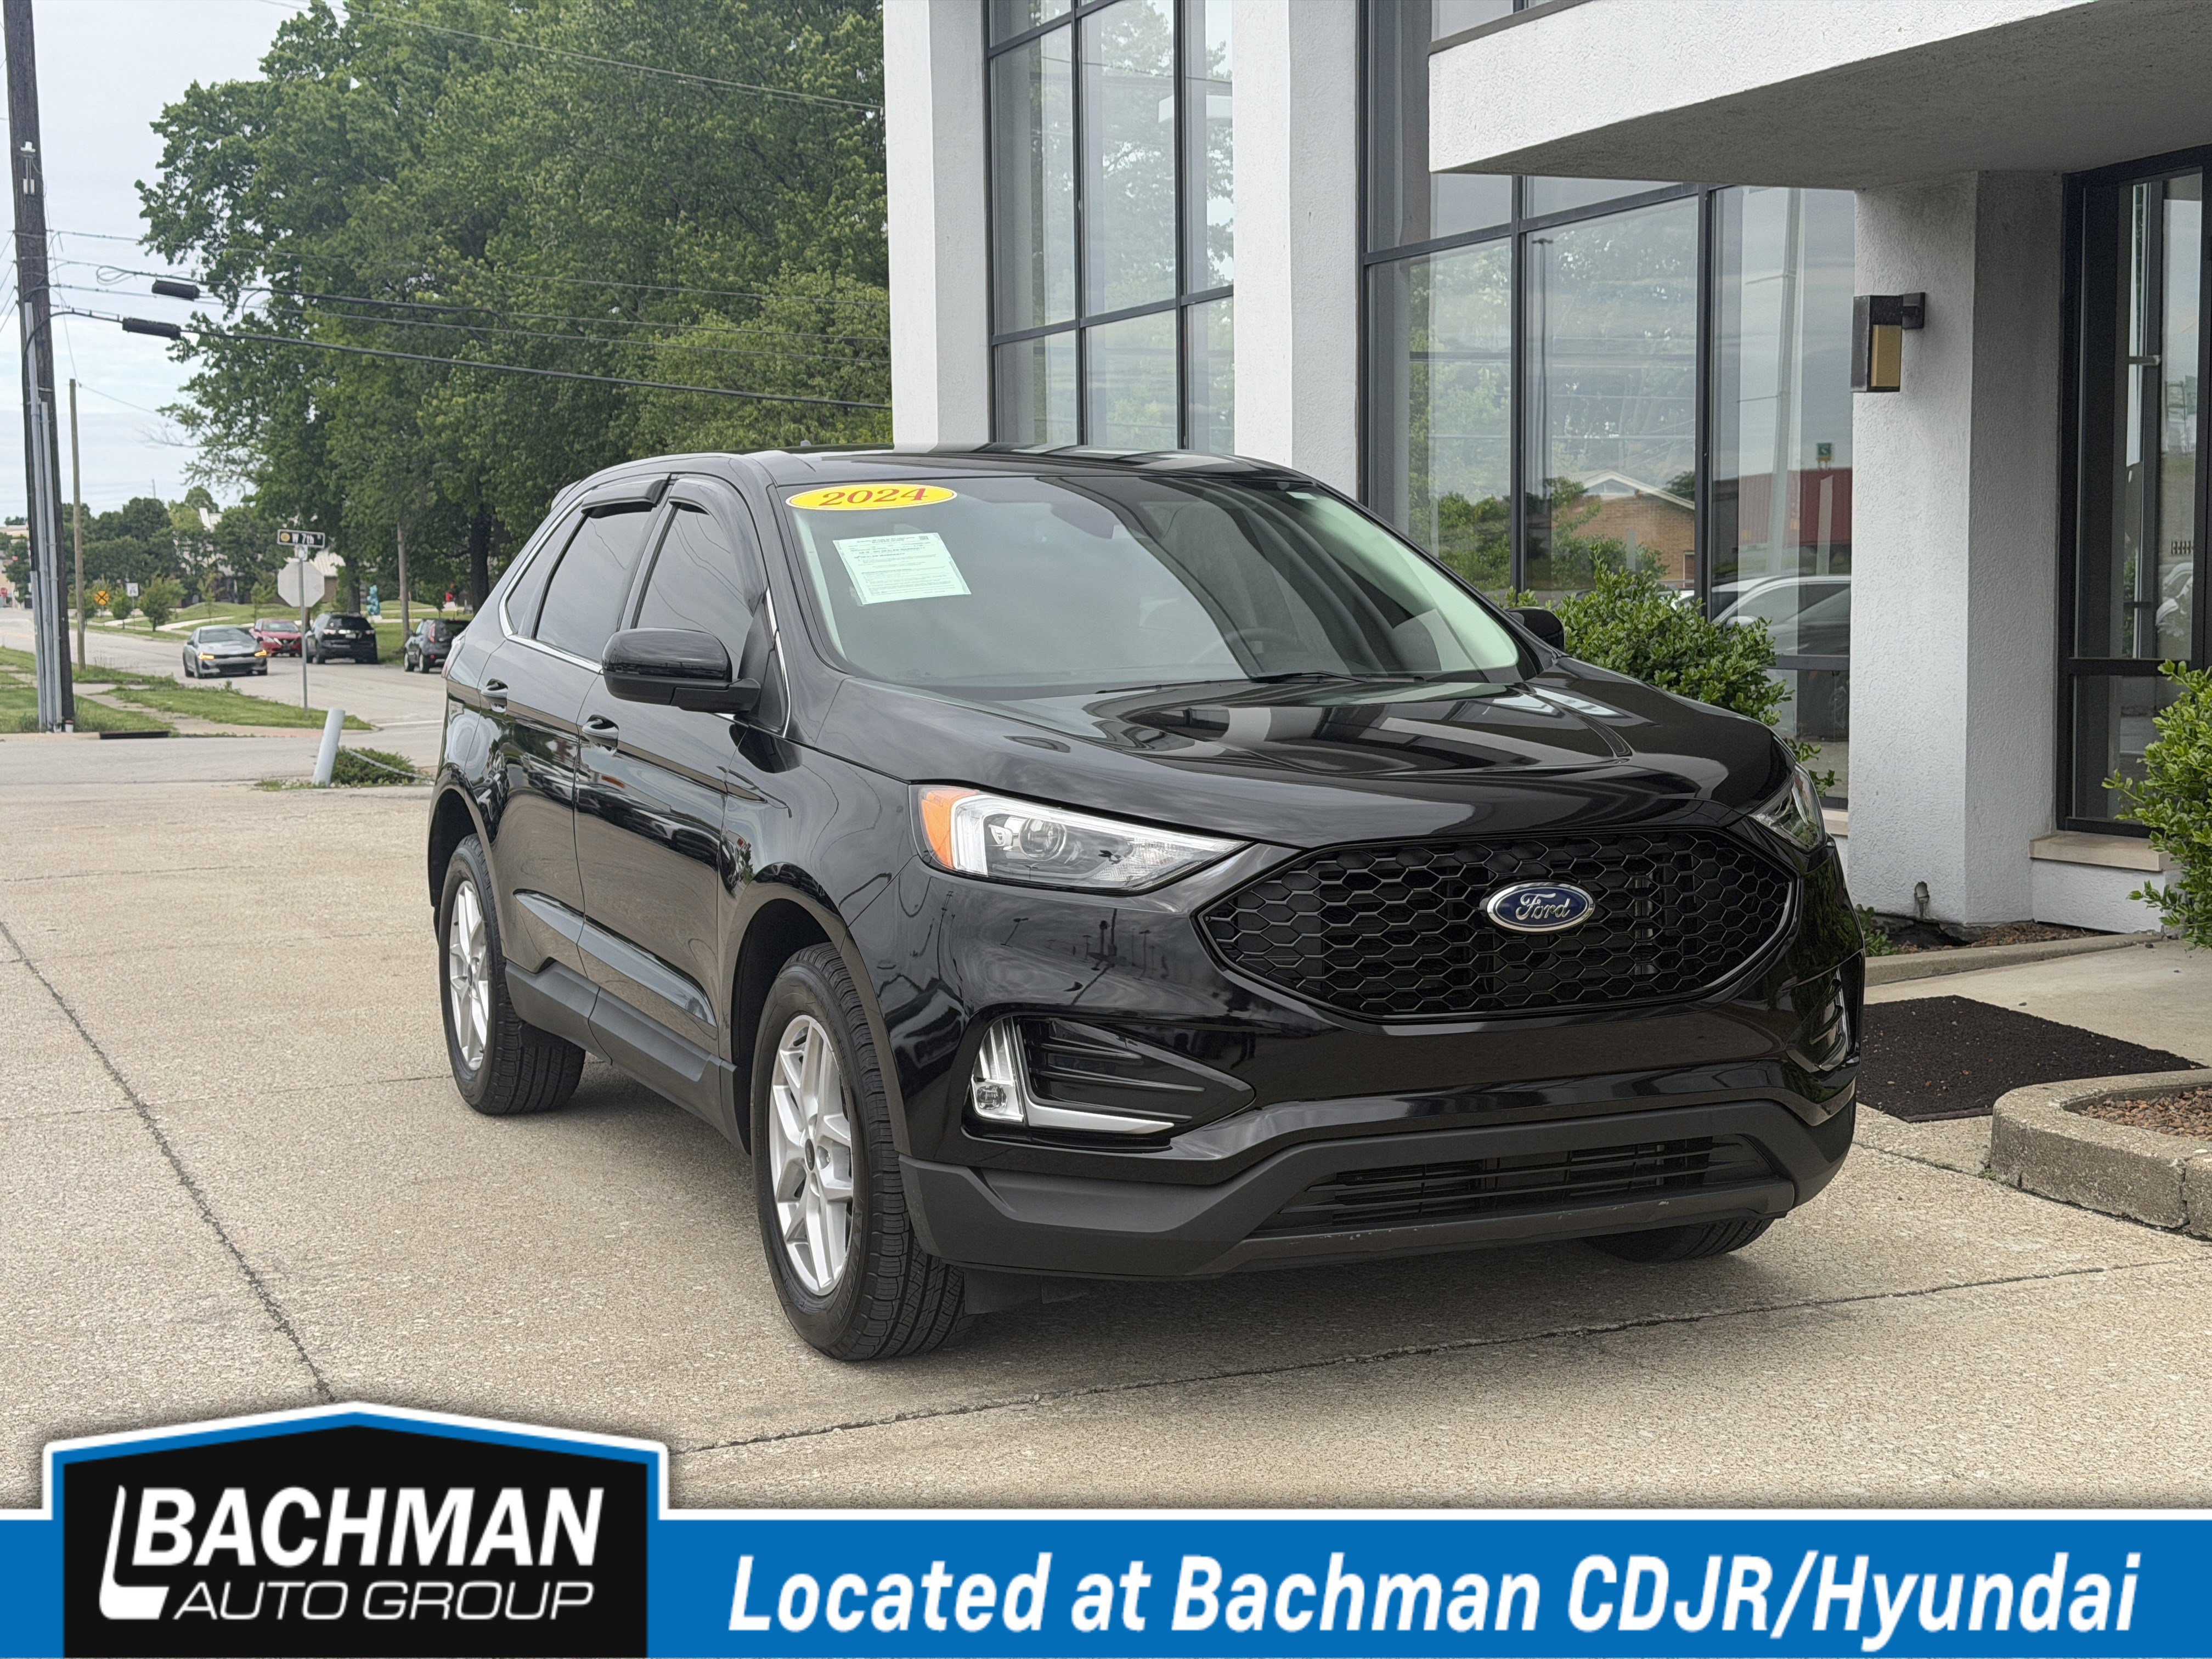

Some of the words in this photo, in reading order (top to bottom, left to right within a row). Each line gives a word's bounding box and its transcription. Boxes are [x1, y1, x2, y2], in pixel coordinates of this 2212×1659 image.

[820, 488, 928, 506] 2024
[292, 533, 299, 543] W
[1515, 893, 1570, 921] Ford
